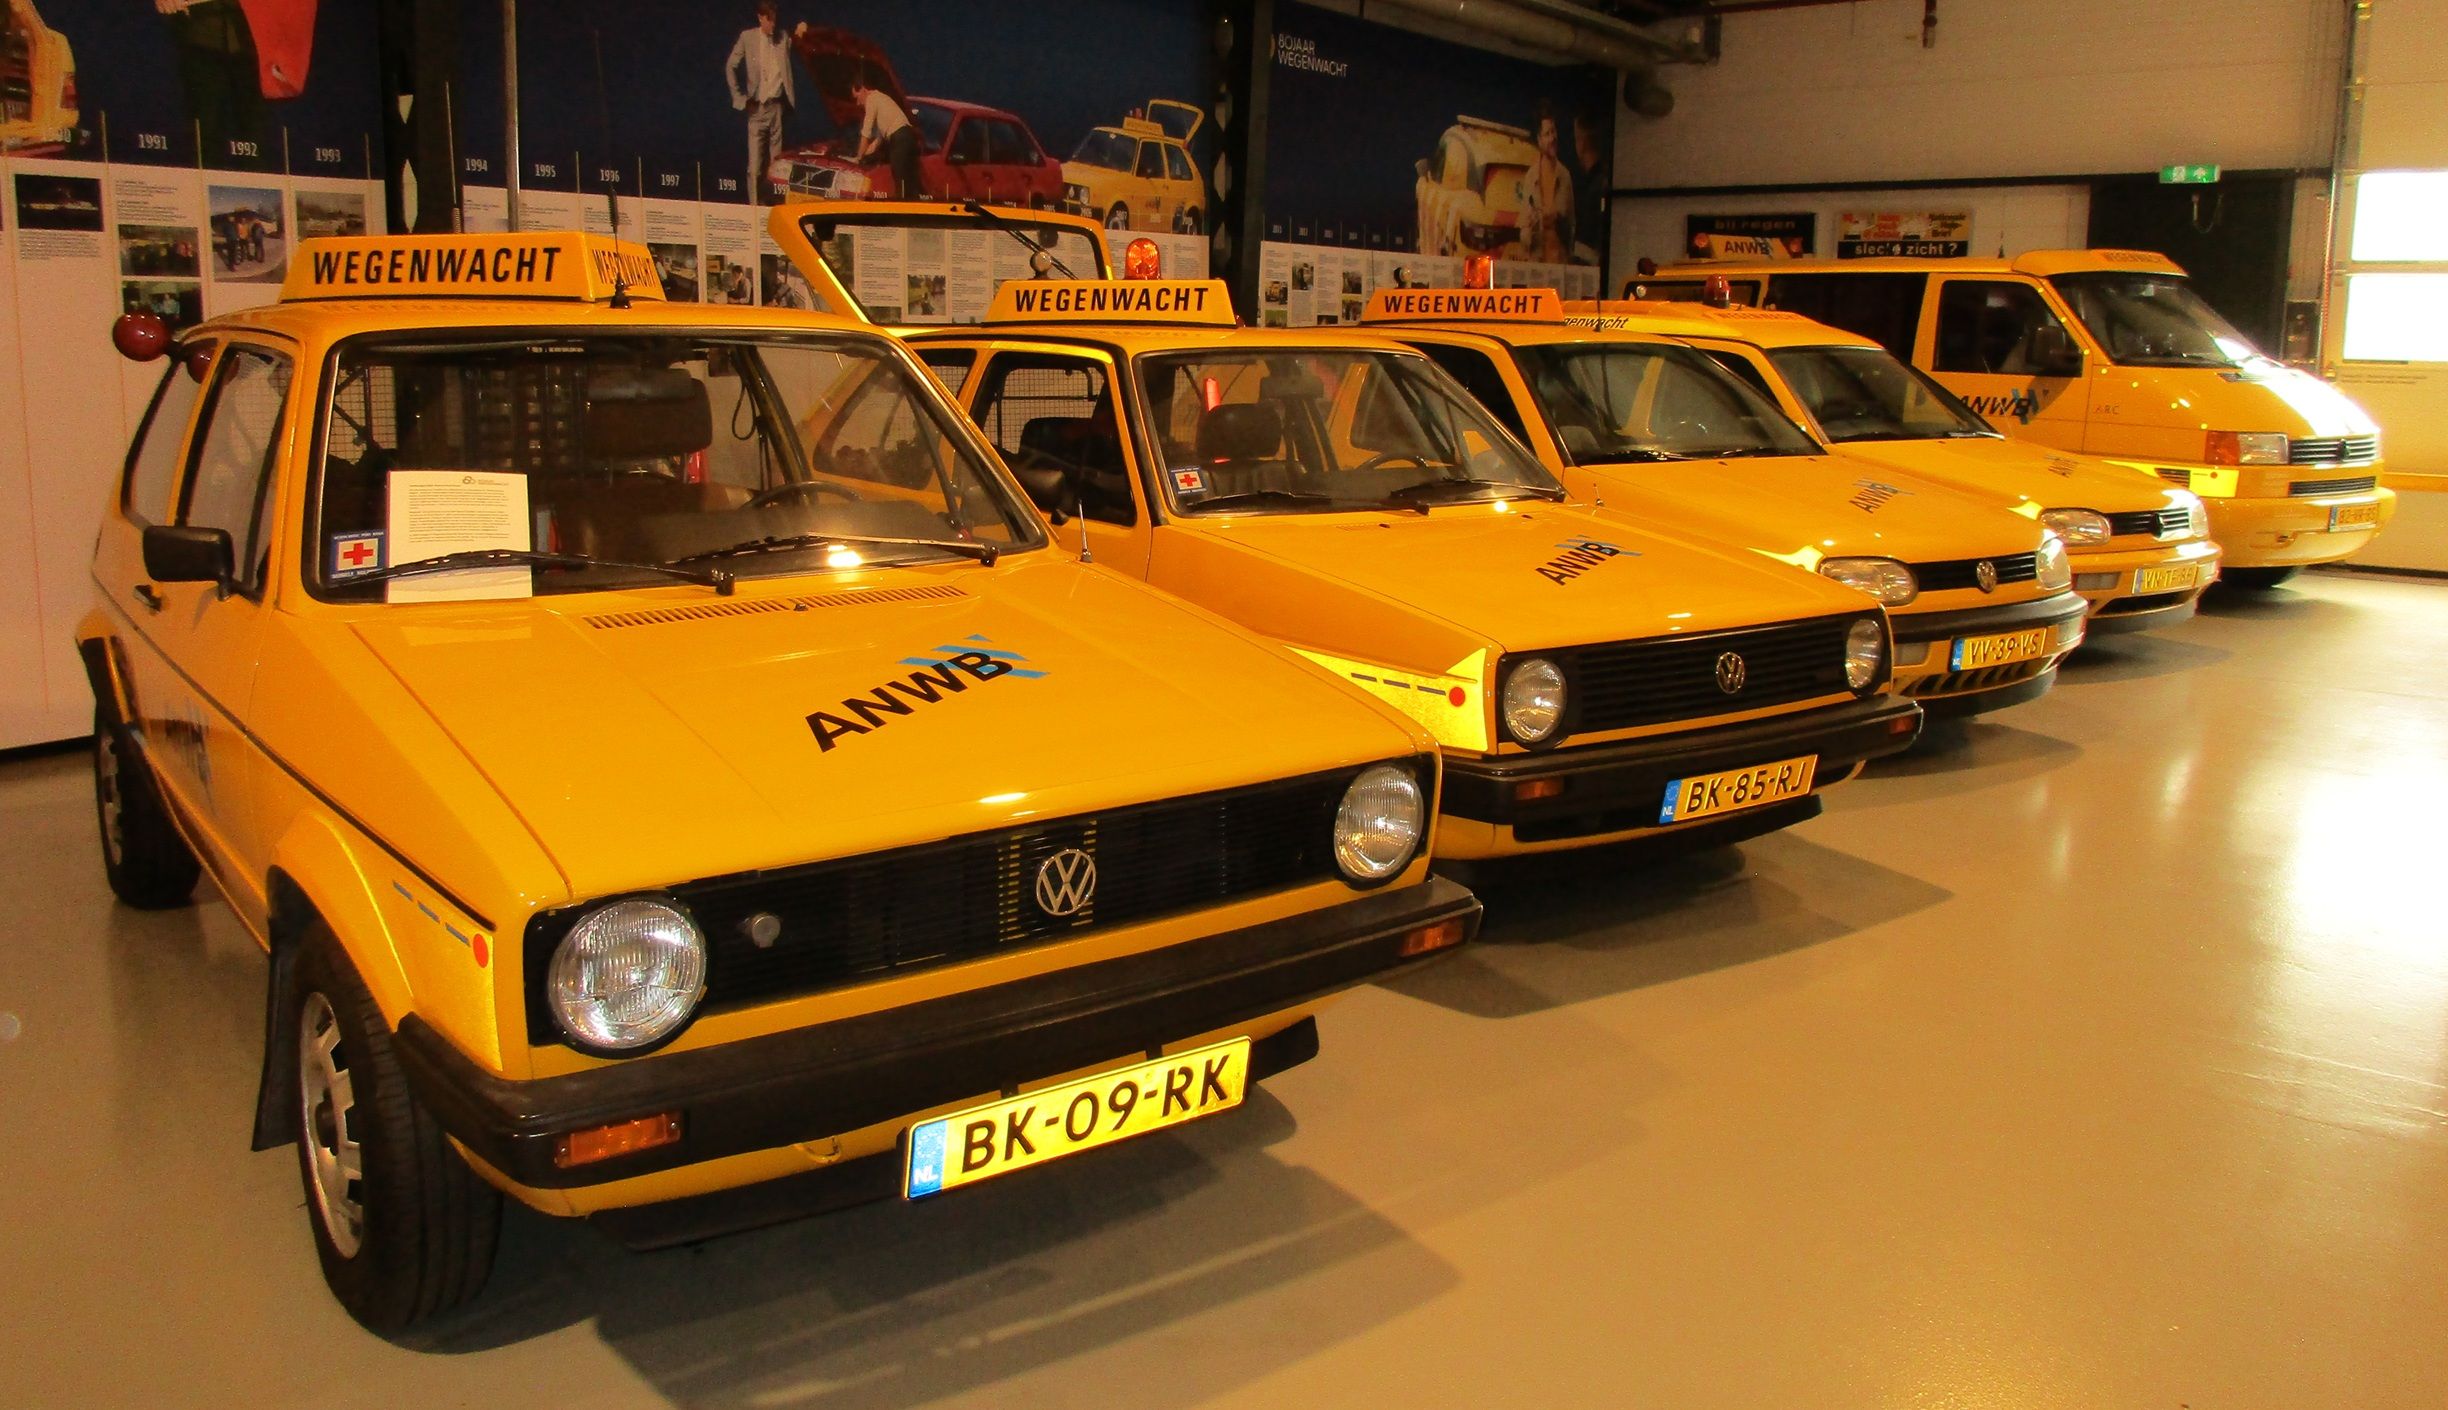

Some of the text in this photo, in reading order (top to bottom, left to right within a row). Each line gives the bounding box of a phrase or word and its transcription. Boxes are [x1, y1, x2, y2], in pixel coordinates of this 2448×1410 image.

[1278, 49, 1348, 77] WEGENWACHT
[138, 133, 168, 150] 1991
[231, 140, 259, 157] 1992
[315, 147, 342, 163] 1993
[465, 157, 488, 172] 1994
[534, 163, 556, 178] 1995
[600, 169, 620, 182] 1996
[661, 174, 680, 187] 1997
[719, 178, 737, 191] 1998
[1724, 241, 1770, 255] ANWB
[1906, 242, 1944, 256] zicht
[1948, 243, 1958, 255] ?
[314, 247, 561, 285] WEGENWACHT
[1015, 287, 1209, 312] WEGENWACHT
[1384, 295, 1543, 314] WEGENWACHT
[1535, 540, 1620, 586] ANWB
[1969, 633, 2039, 665] VV-39-VS
[804, 651, 1013, 753] ANWB
[1662, 761, 1806, 817] NL BK-85-RJ
[912, 1054, 1231, 1185] NL BK-09-RK
